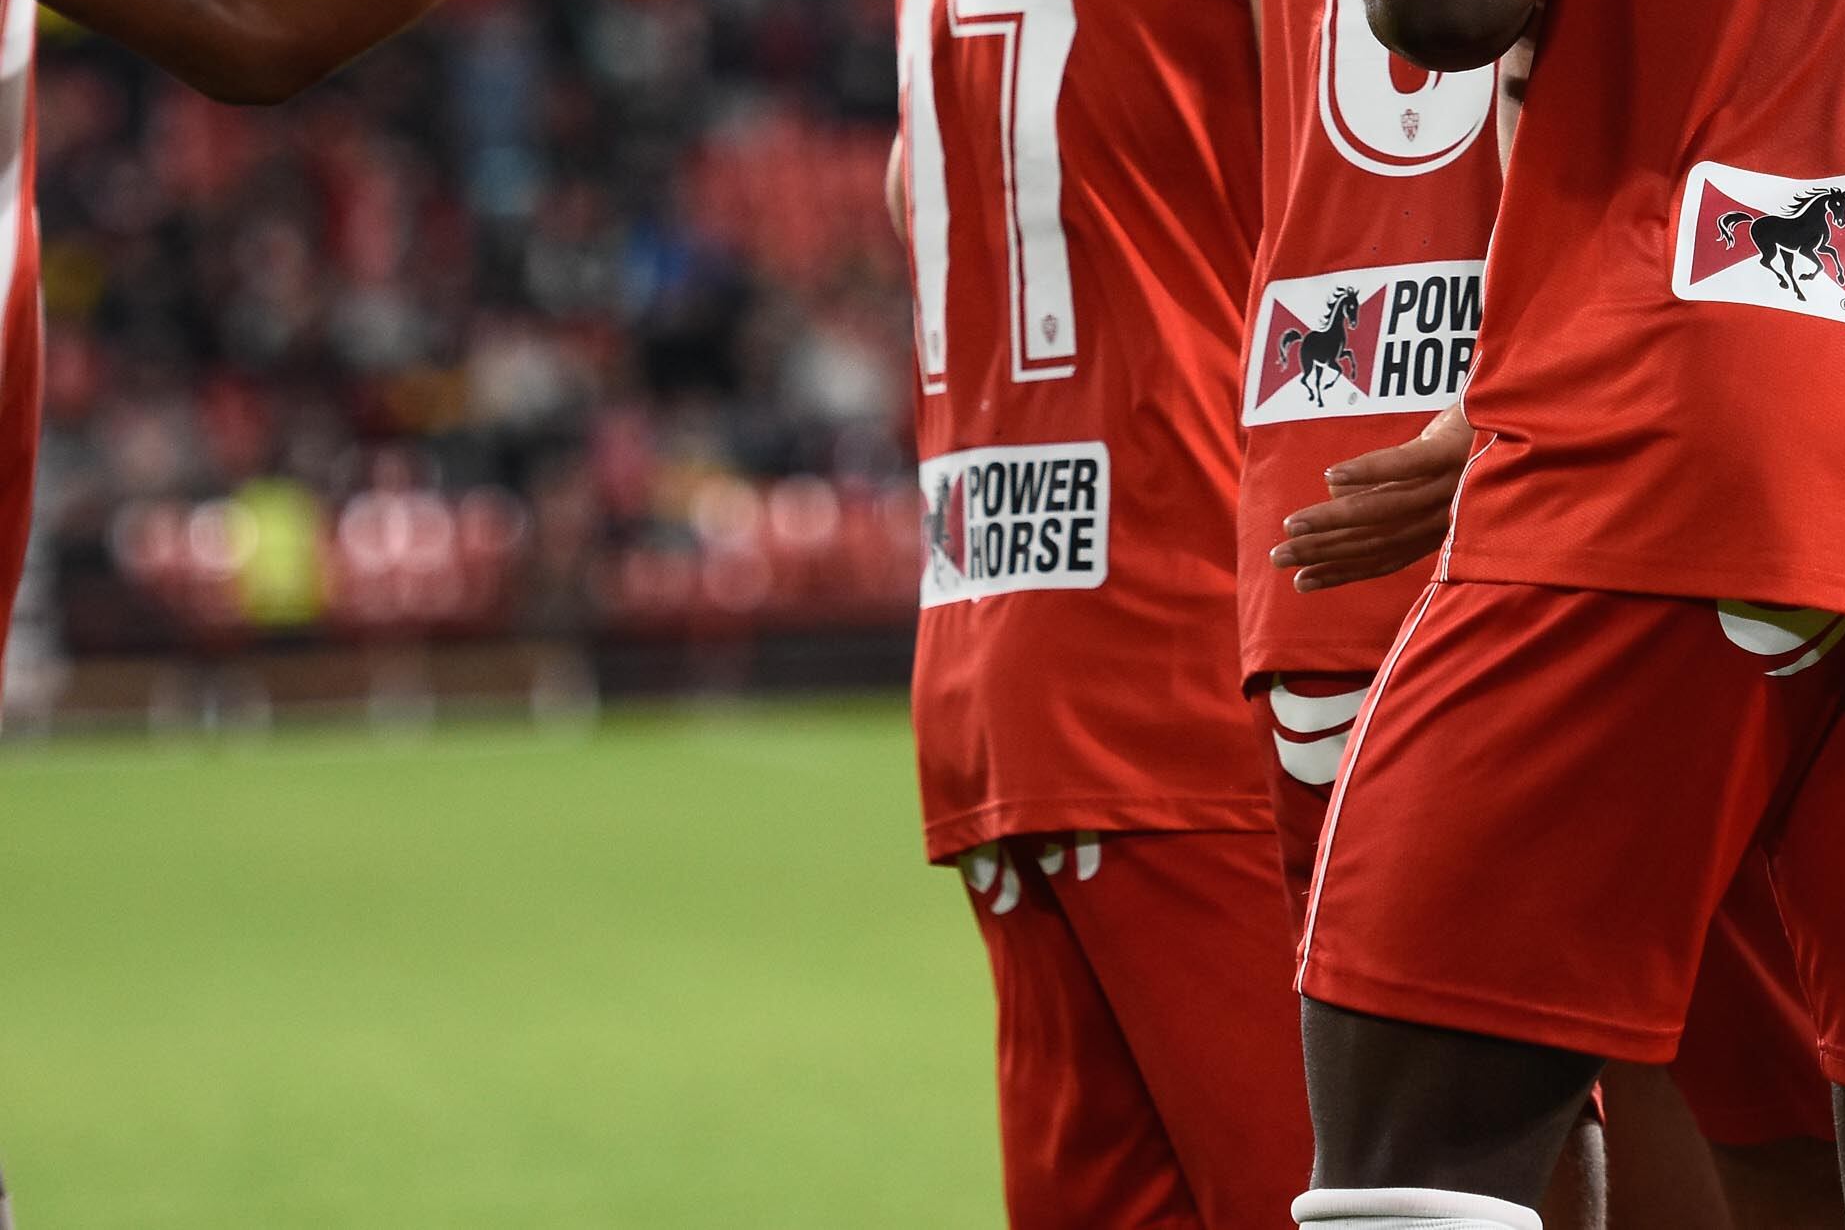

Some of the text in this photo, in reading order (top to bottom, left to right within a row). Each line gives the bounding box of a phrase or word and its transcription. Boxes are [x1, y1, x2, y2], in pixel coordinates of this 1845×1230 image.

[1388, 275, 1483, 335] POW
[1379, 337, 1476, 398] HOR
[968, 458, 1098, 519] POWER
[969, 518, 1095, 581] HORSE
